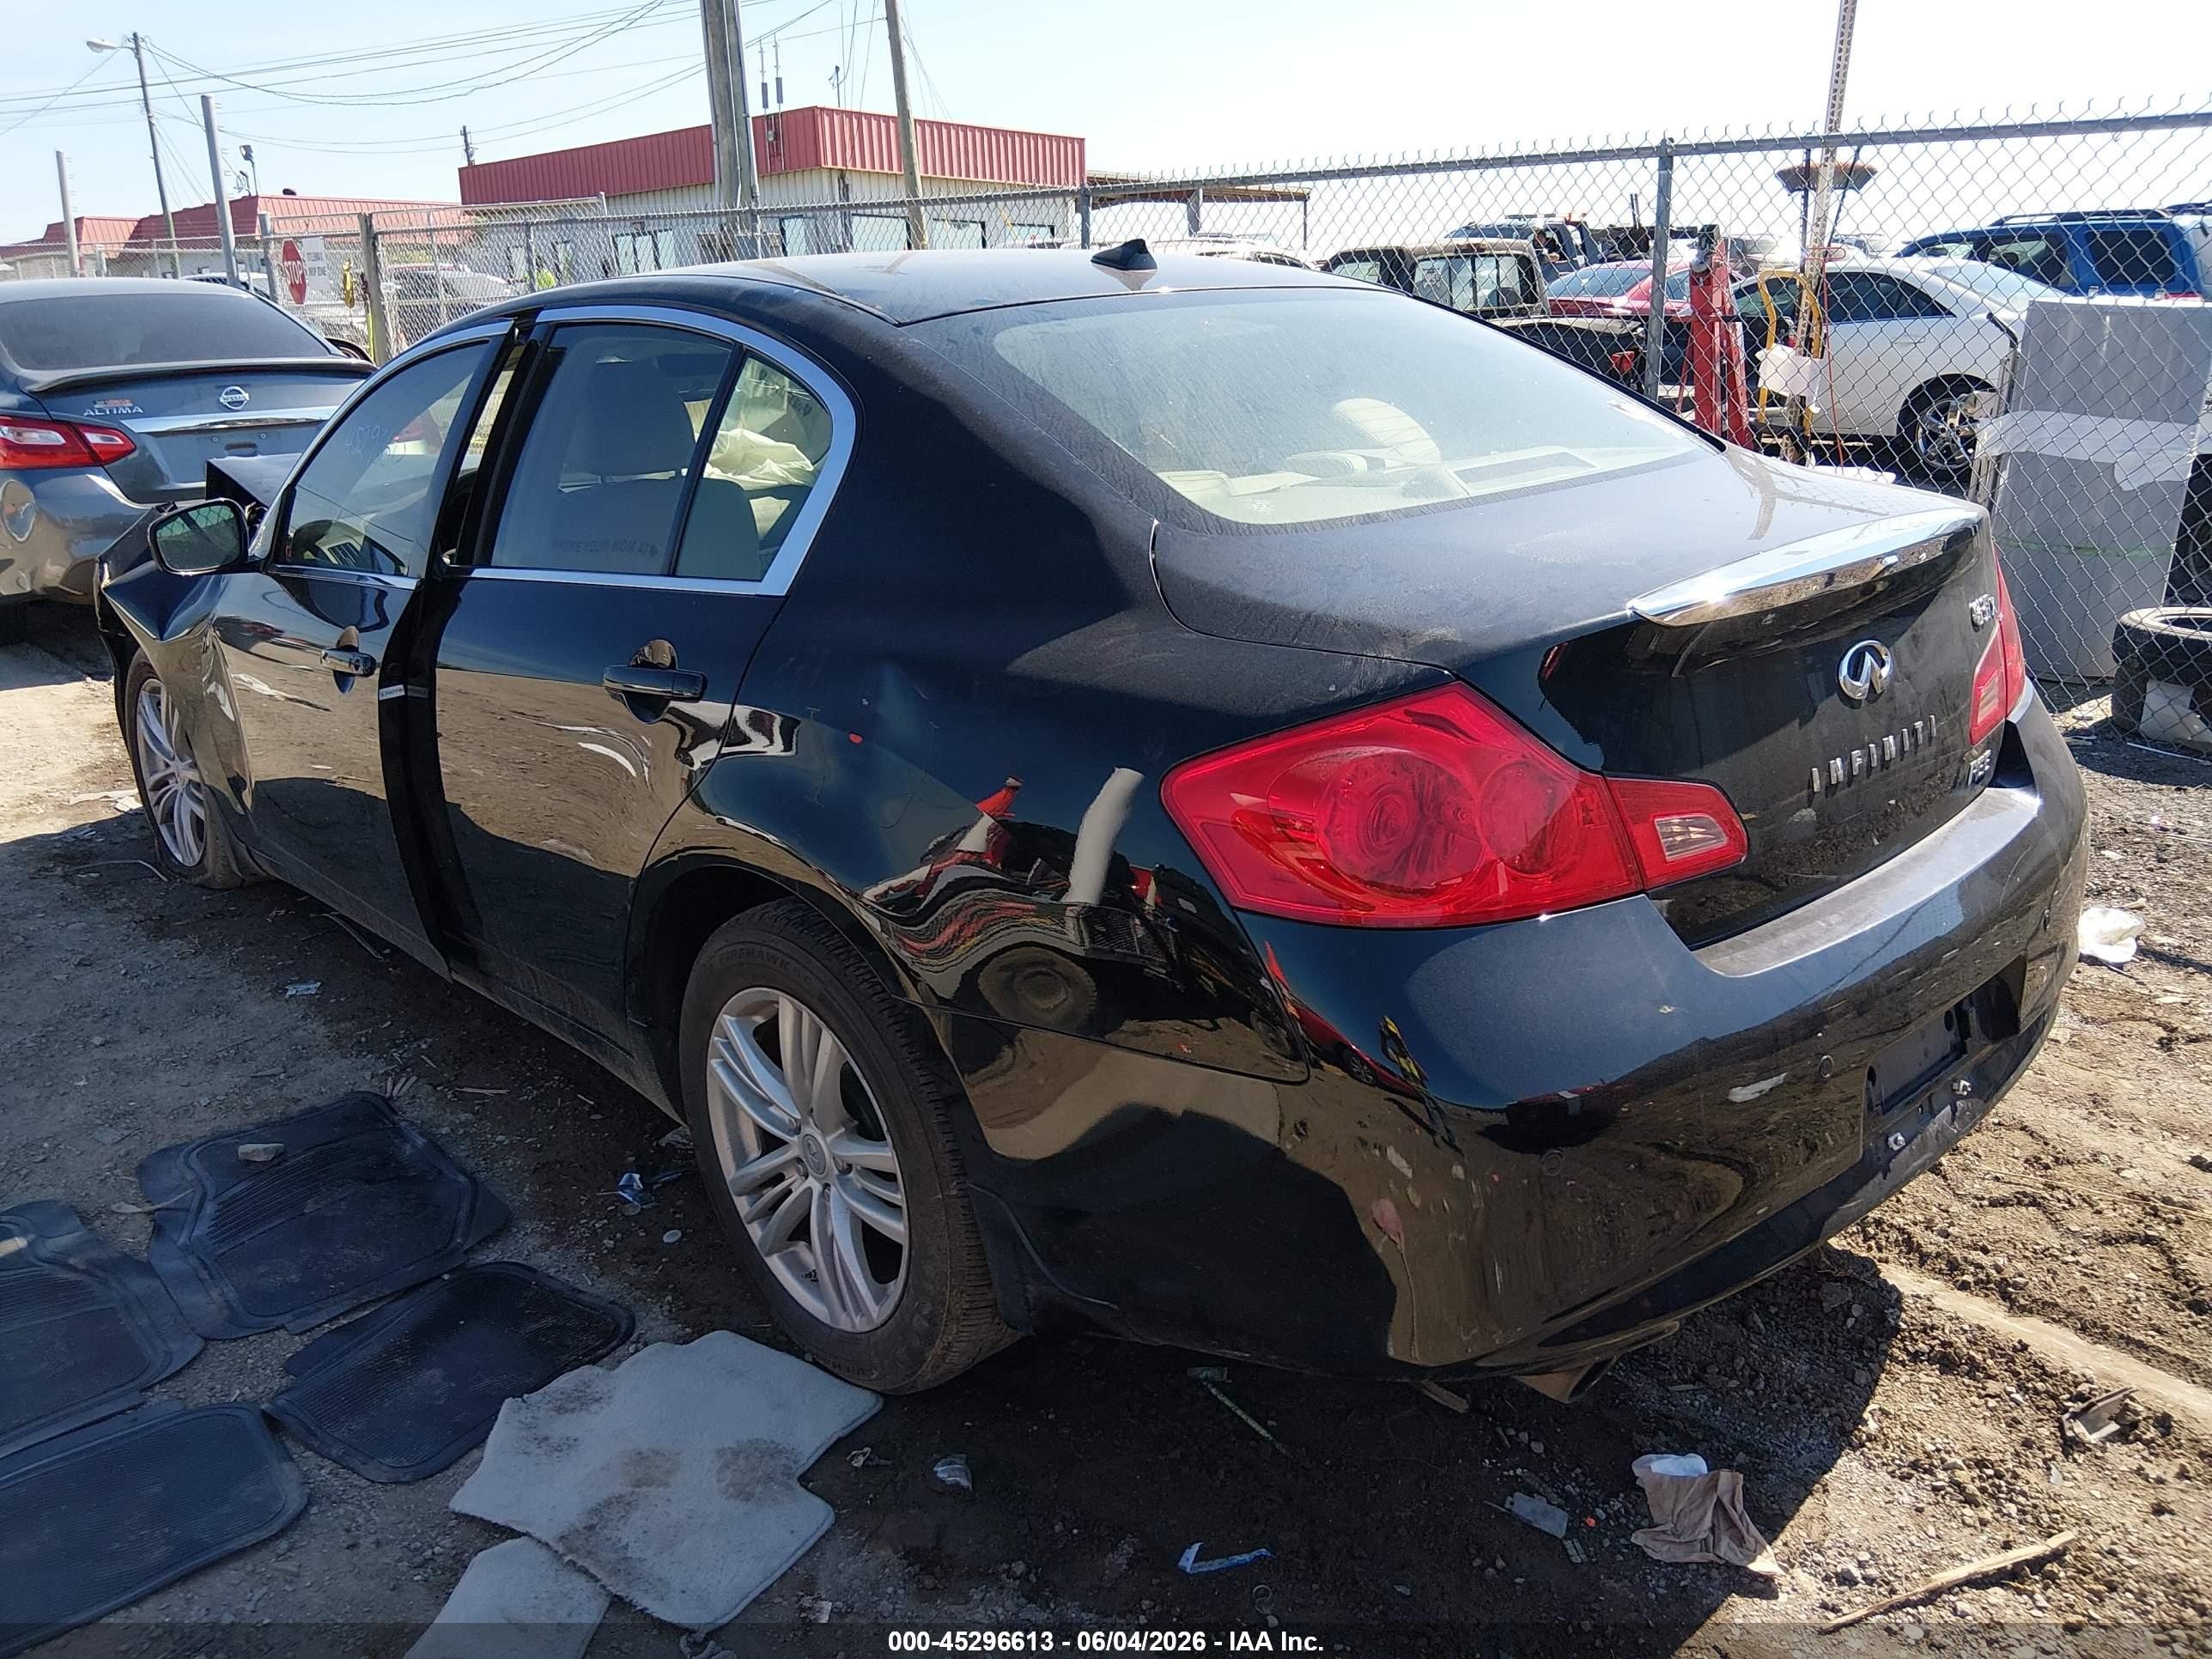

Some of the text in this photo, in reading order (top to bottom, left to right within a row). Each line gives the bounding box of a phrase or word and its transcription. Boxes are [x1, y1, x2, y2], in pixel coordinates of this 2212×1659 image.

[284, 260, 303, 285] STOP
[82, 406, 144, 416] ALTIMA
[1811, 714, 1937, 793] INFINITI
